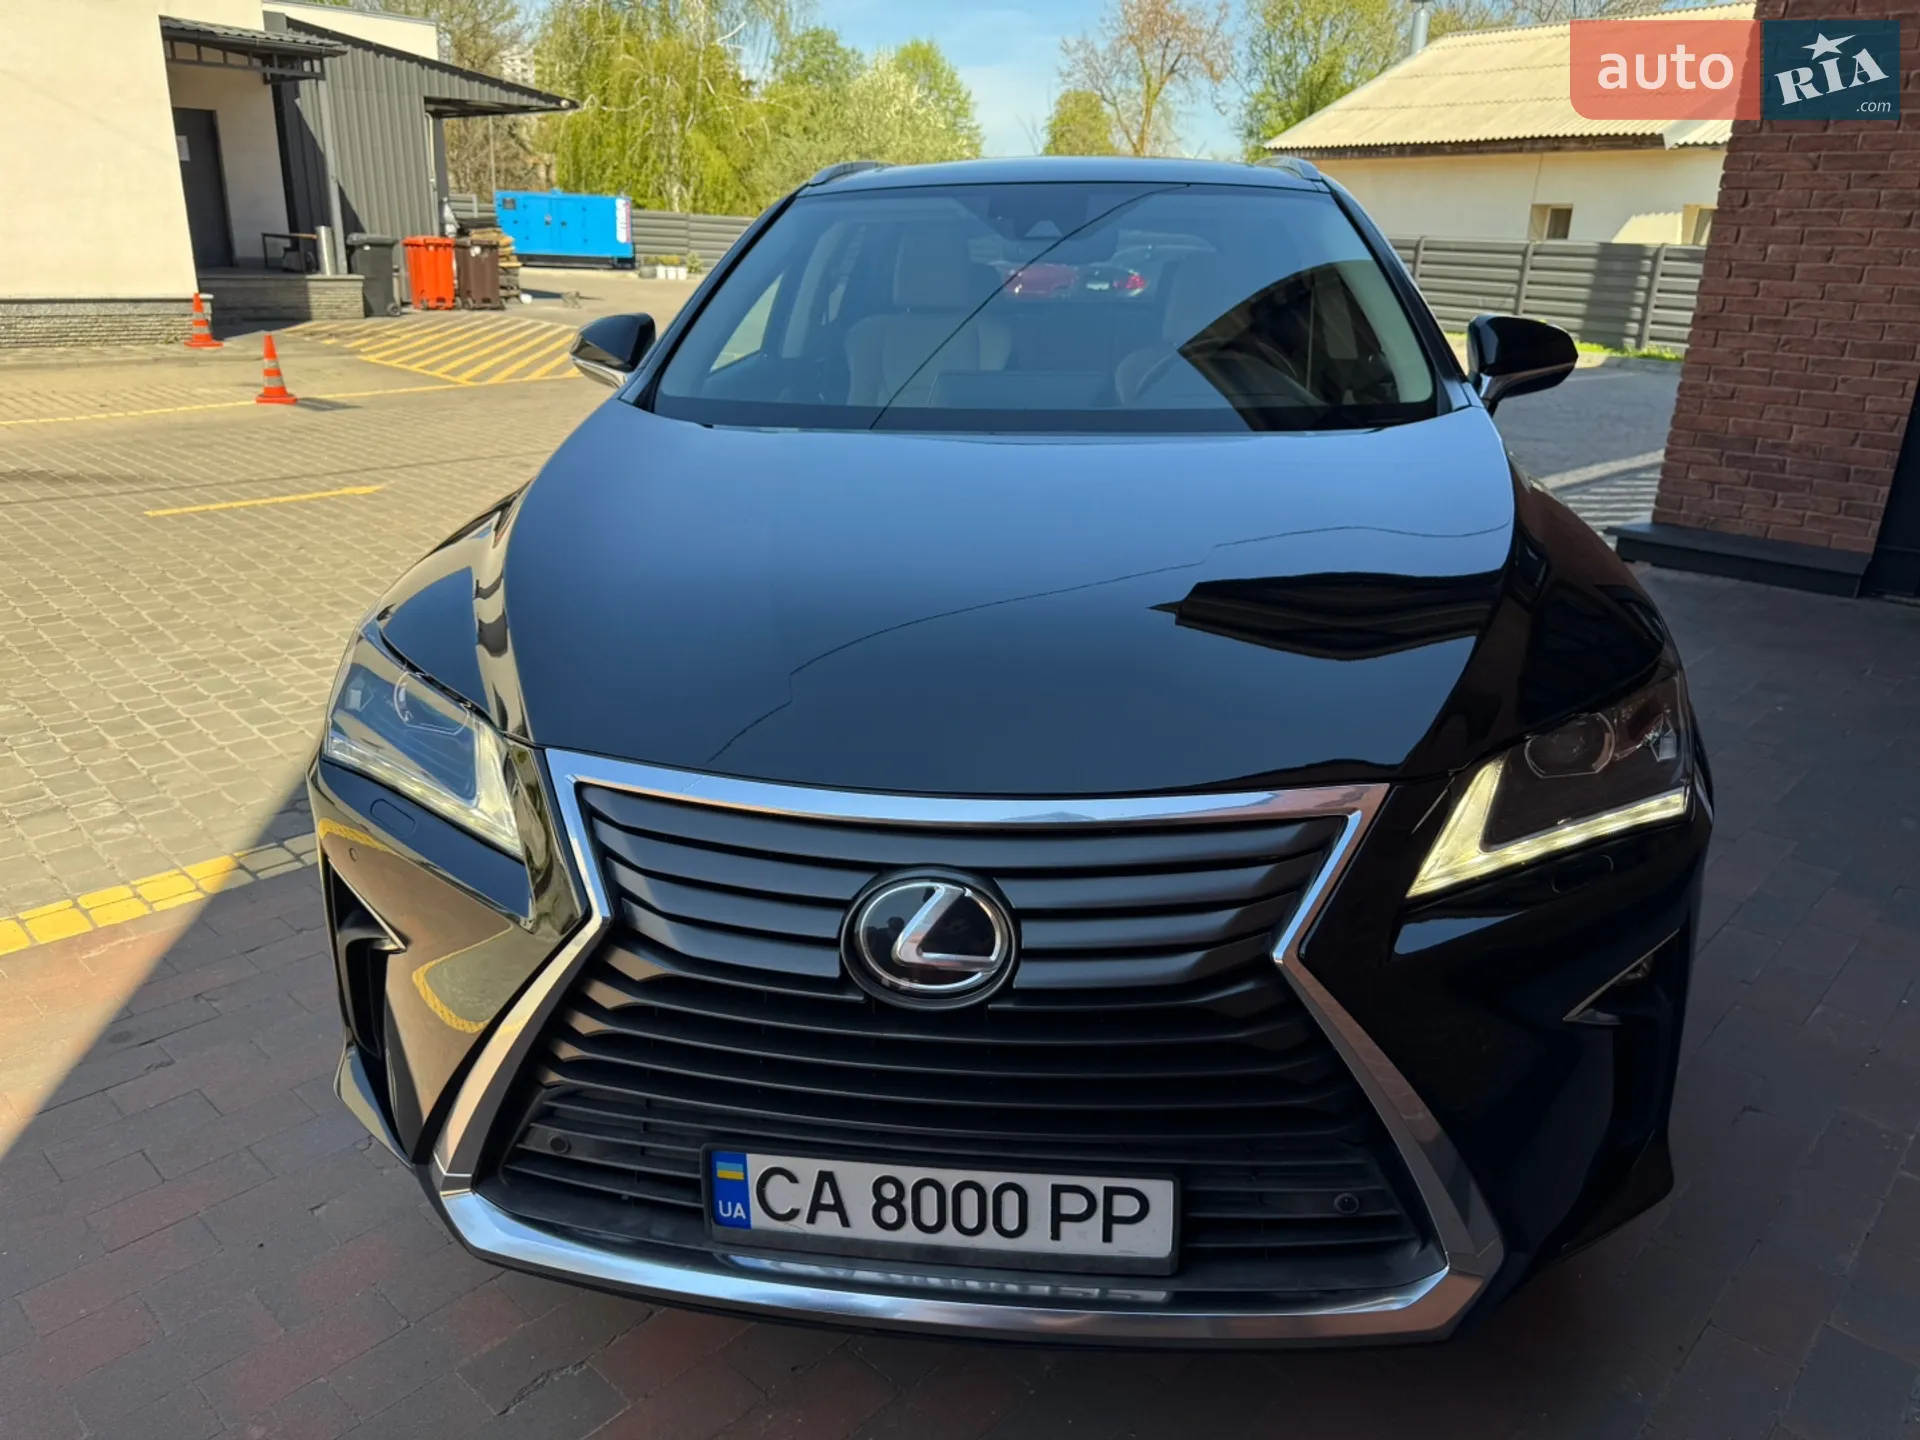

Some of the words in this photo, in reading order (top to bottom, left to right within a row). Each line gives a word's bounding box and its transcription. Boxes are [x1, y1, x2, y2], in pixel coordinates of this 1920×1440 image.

[718, 1199, 747, 1220] UA
[755, 1166, 851, 1228] CA
[871, 1175, 1029, 1239] 8000
[1050, 1183, 1150, 1243] PP
